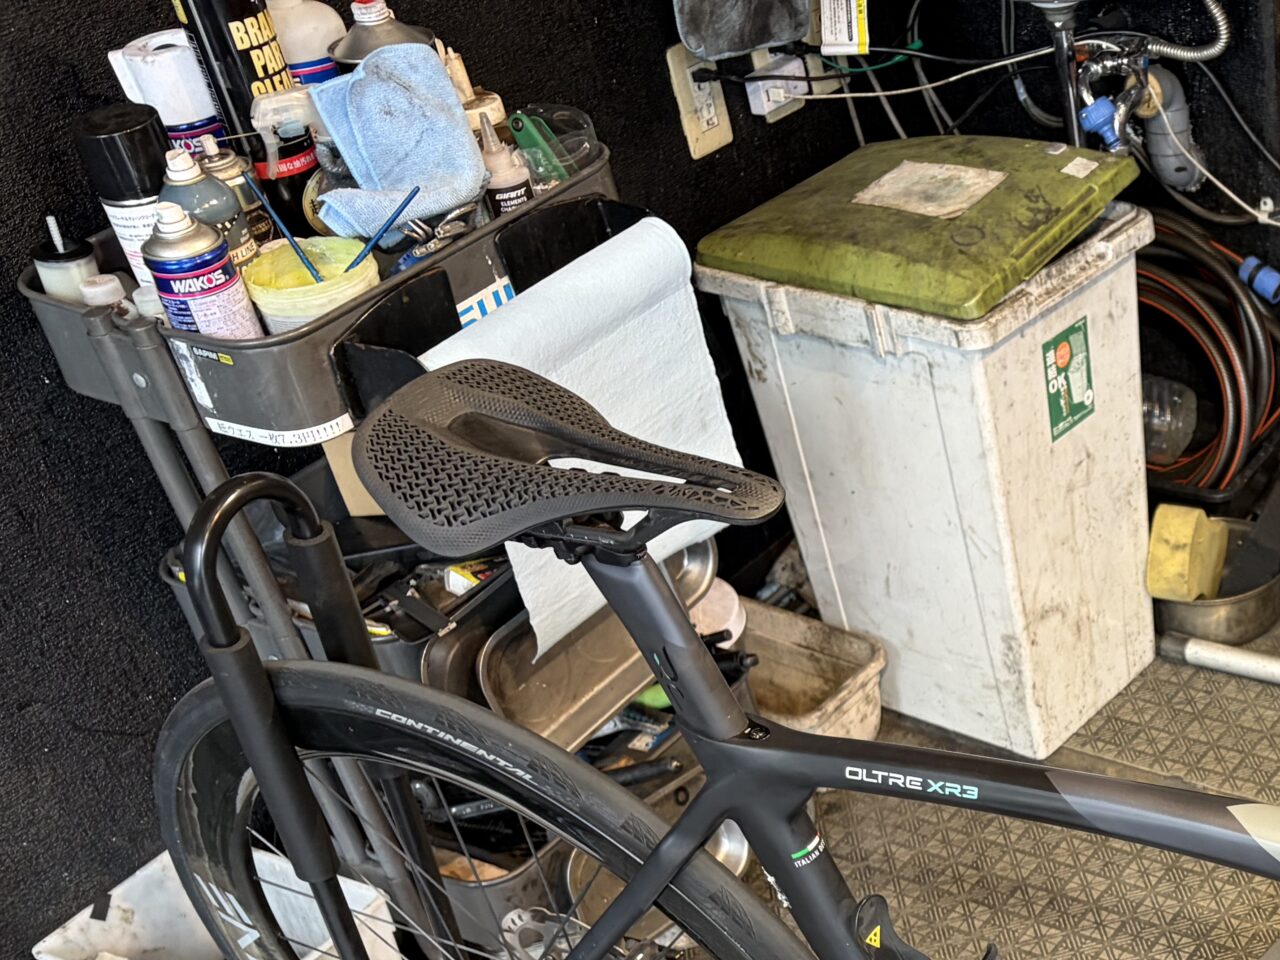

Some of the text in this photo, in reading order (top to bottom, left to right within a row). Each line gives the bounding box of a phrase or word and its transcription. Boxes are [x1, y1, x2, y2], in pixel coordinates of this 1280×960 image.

[495, 187, 526, 200] GIANT
[500, 196, 527, 207] ELEMENTS
[1048, 372, 1067, 394] OK
[375, 708, 539, 786] CONTINENTAL
[845, 766, 979, 800] OLTRE XR3
[794, 849, 820, 868] ITALIAN
